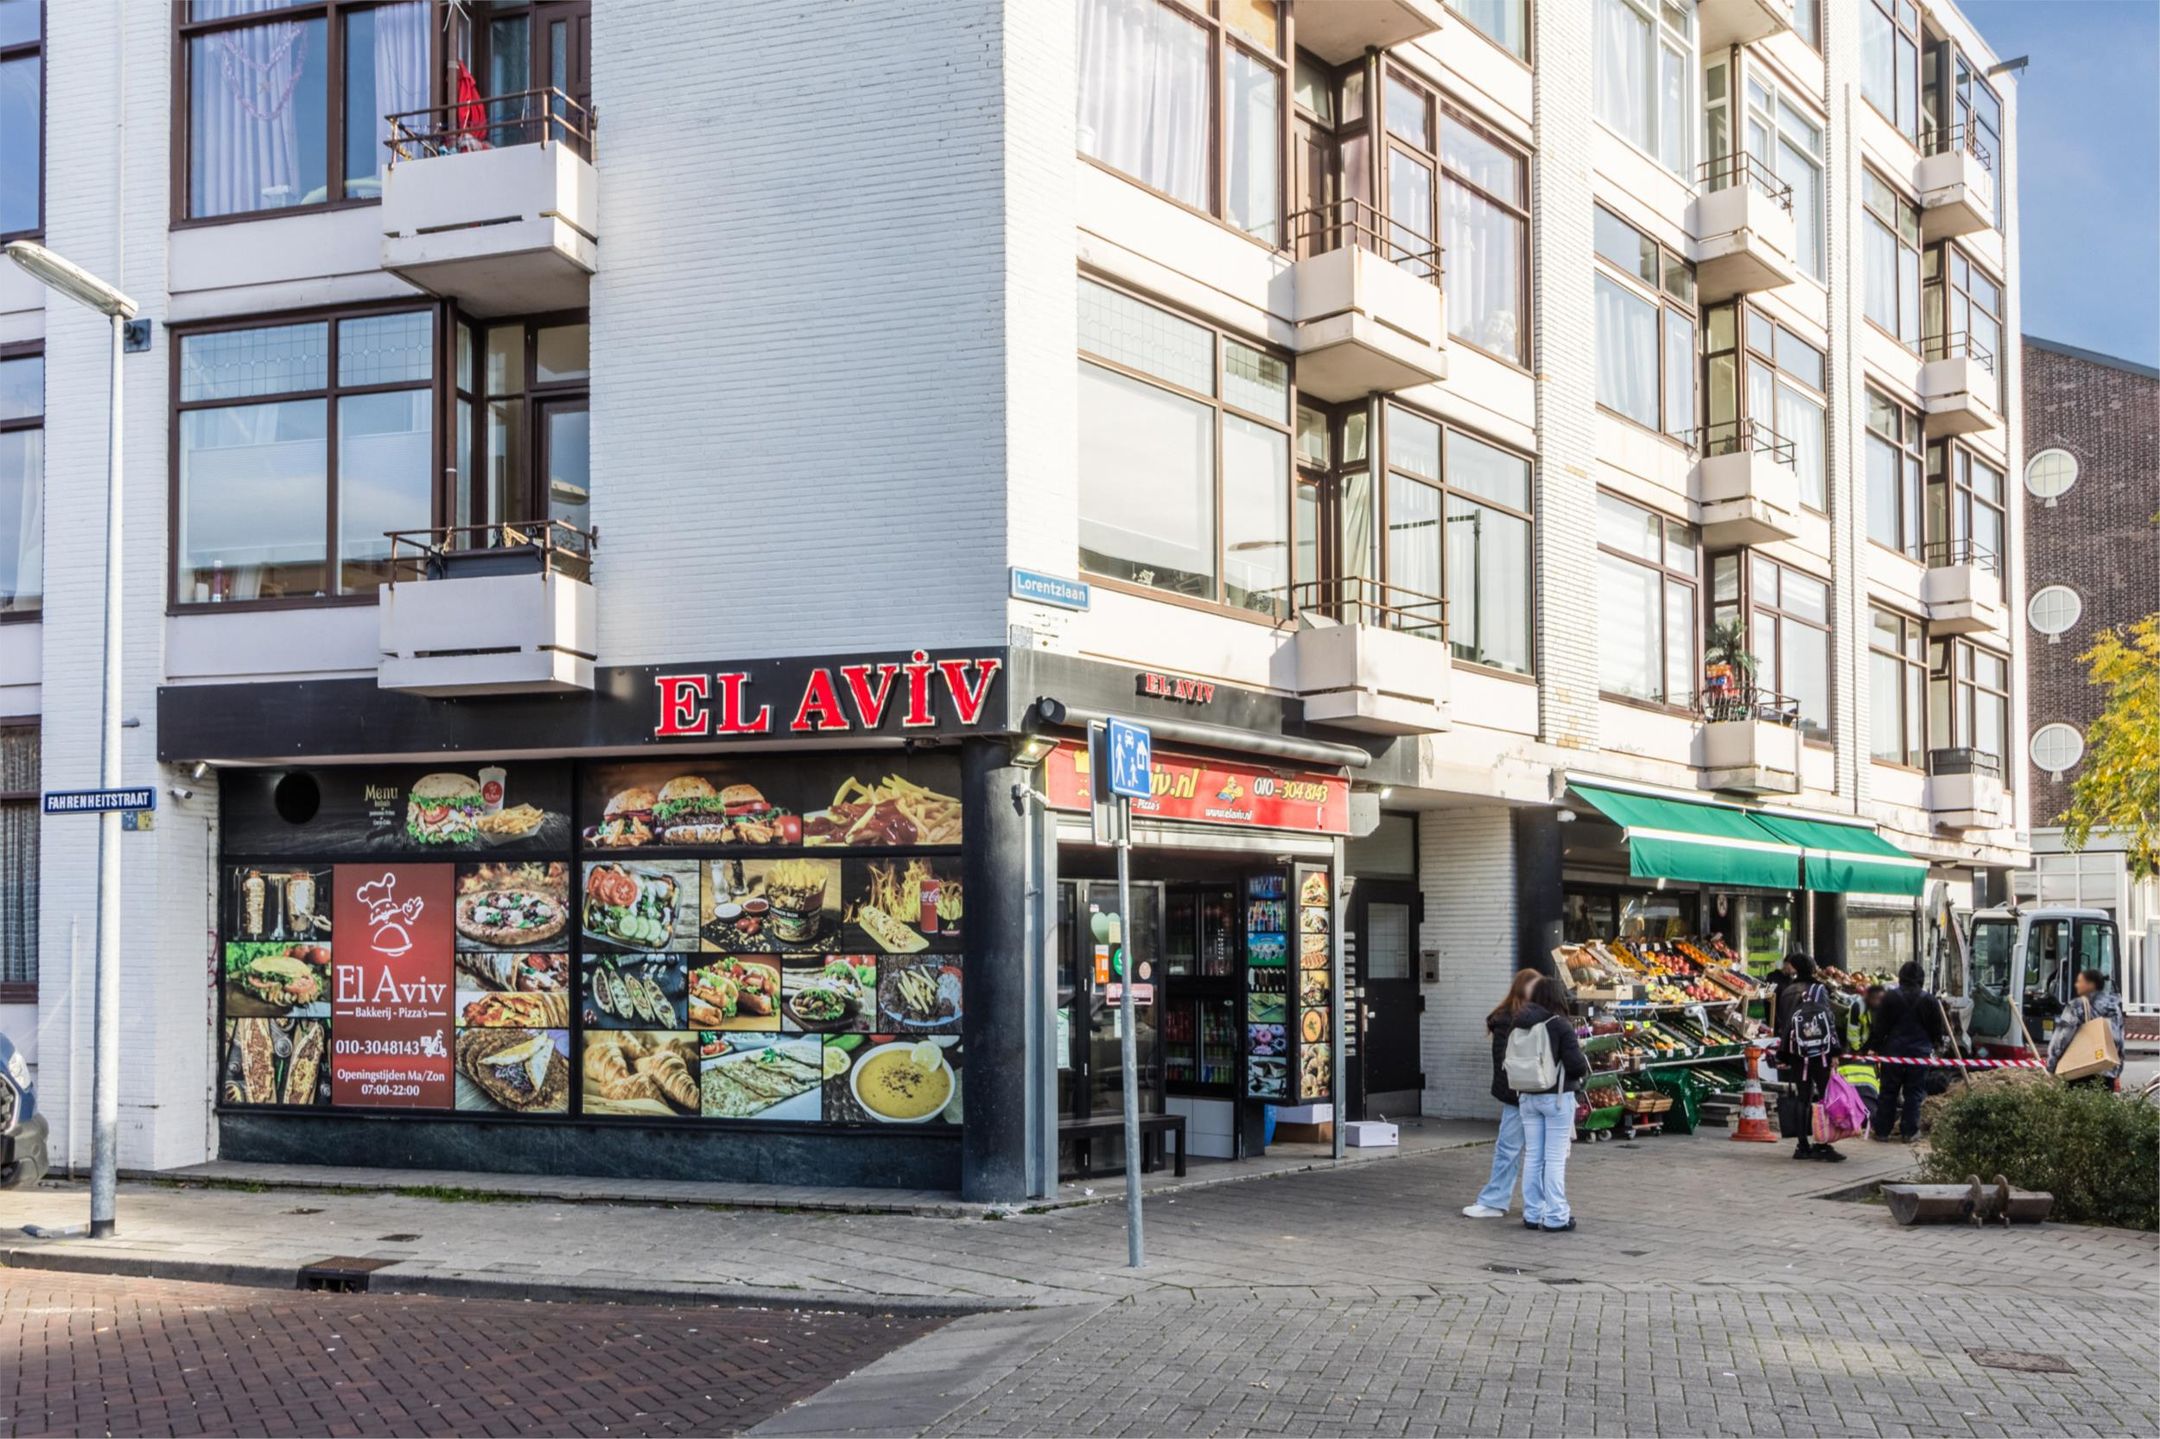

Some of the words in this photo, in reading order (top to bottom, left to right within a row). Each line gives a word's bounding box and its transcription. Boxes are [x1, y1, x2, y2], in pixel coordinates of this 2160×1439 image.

[1017, 574, 1086, 602] Lorentzlaan
[1145, 672, 1171, 696] EL
[655, 673, 771, 736] EL
[47, 791, 150, 810] FAHRENHEITSTRAAT
[364, 784, 399, 801] Menu
[336, 964, 366, 1003] El
[371, 964, 447, 1004] Aviv
[355, 1006, 392, 1020] Bakkerij
[398, 1007, 428, 1018] Pizza's
[335, 1039, 420, 1055] 010-3048143
[337, 1068, 406, 1083] Openingstijden
[407, 1069, 445, 1083] Ma/Zon
[361, 1083, 420, 1096] 07:00-22:00
